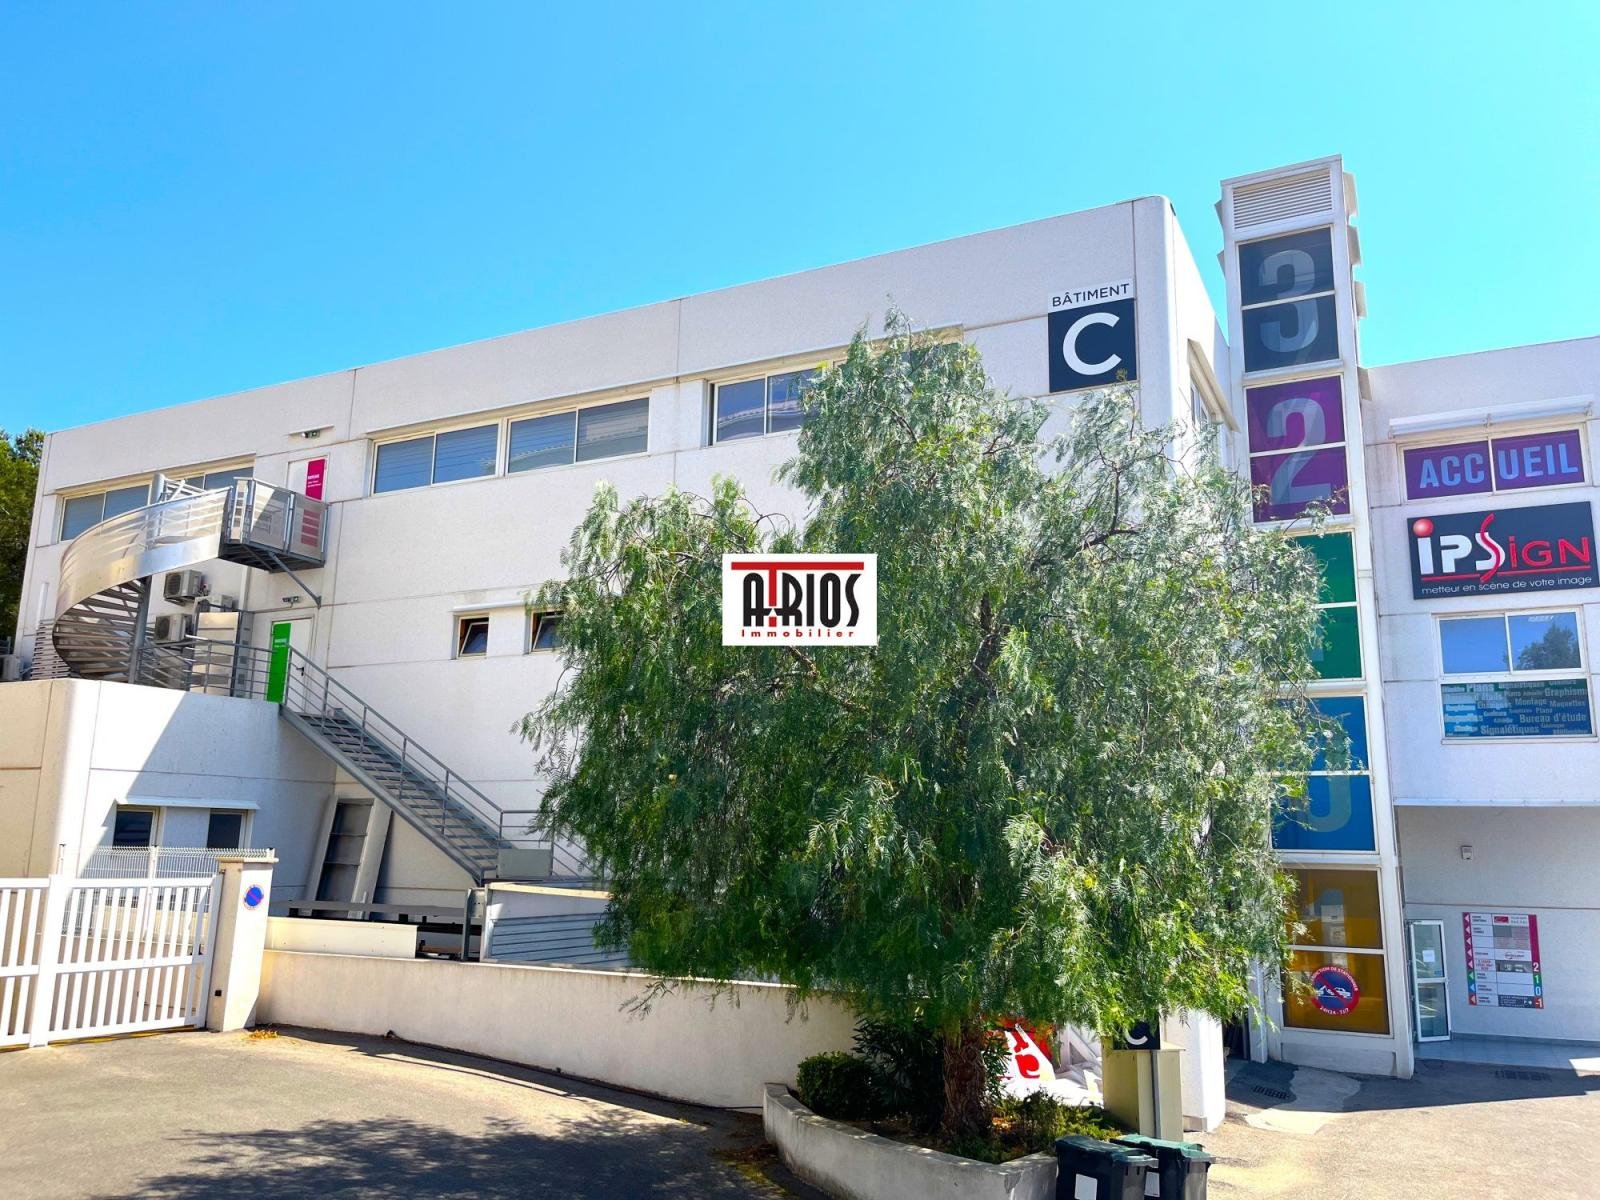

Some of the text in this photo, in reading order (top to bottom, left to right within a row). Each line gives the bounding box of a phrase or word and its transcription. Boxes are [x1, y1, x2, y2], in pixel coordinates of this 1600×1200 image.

[1052, 282, 1130, 308] BÂTIMENT
[1258, 249, 1320, 353] 3
[1062, 311, 1123, 376] C
[1266, 397, 1332, 506] 2
[1421, 584, 1460, 596] metteur
[1462, 584, 1477, 593] en
[1512, 579, 1528, 589] de
[1530, 577, 1555, 587] votre
[1557, 576, 1592, 588] image
[1532, 962, 1540, 972] 2
